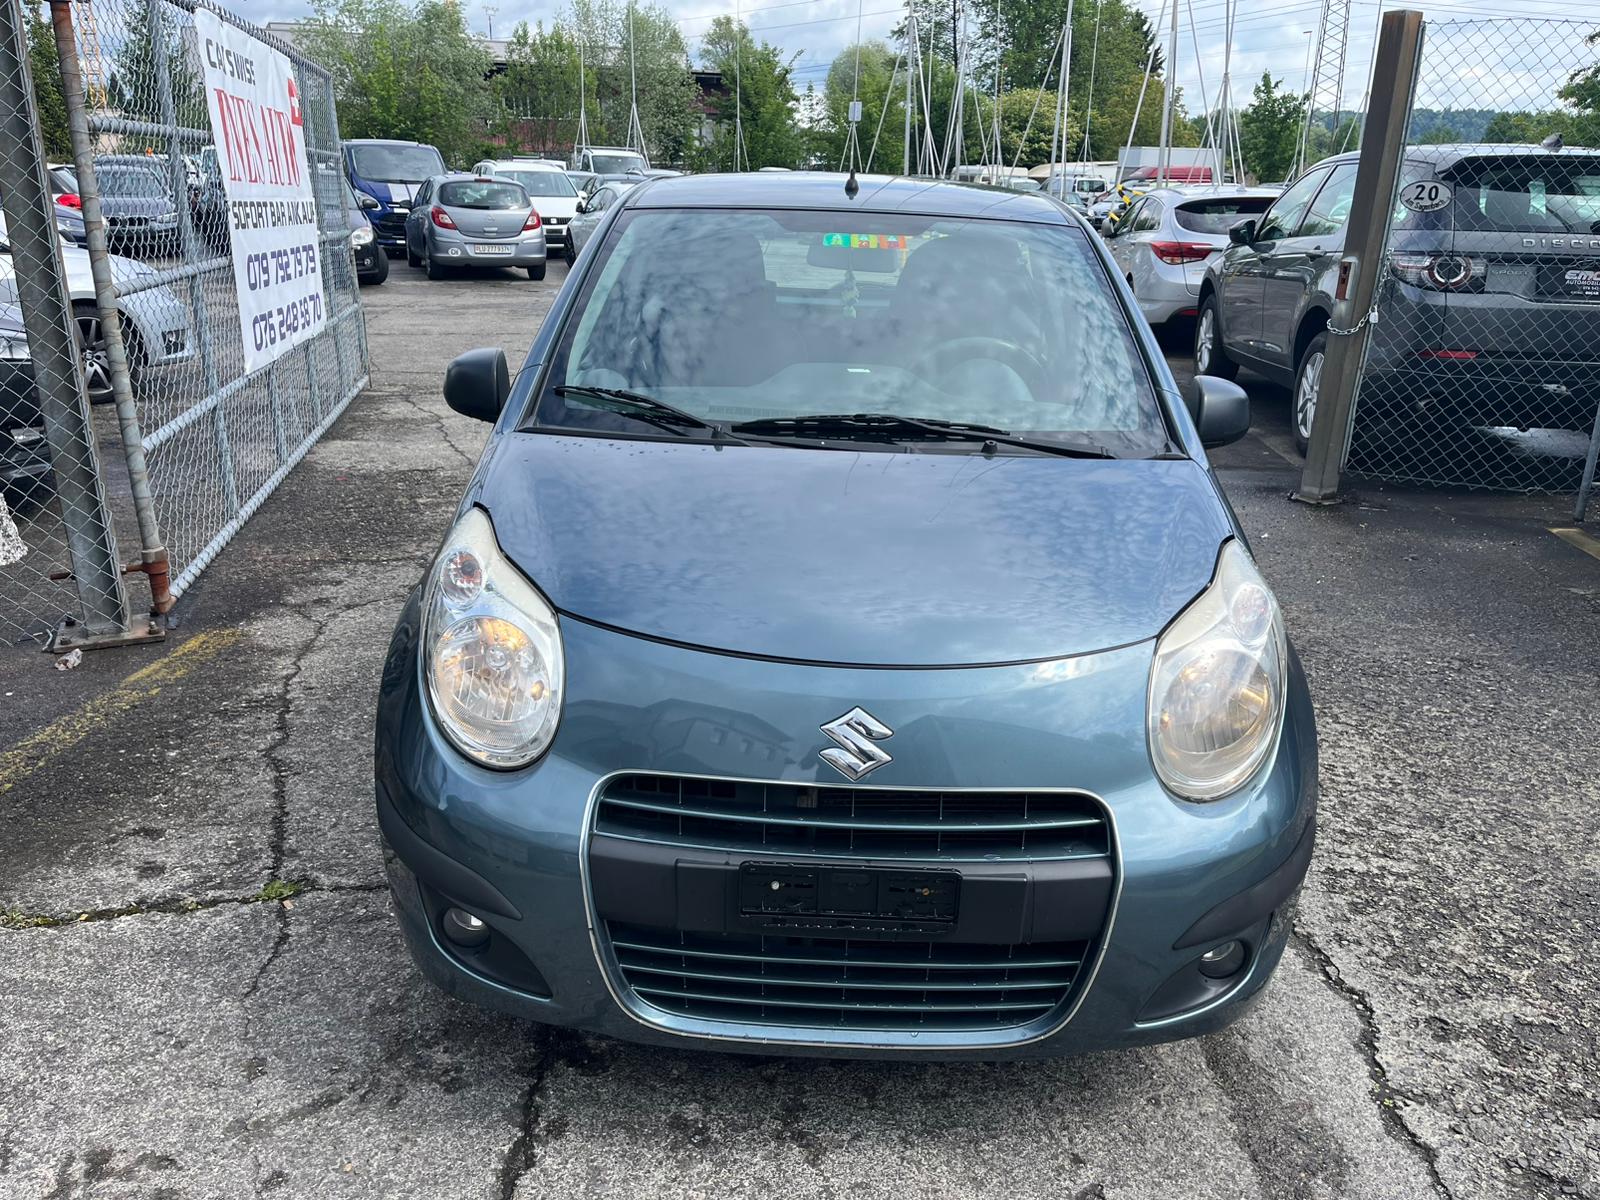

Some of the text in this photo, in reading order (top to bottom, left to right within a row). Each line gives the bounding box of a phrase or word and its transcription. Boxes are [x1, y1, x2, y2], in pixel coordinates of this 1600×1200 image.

[260, 104, 301, 188] AUTO
[231, 200, 269, 230] SOFORT
[268, 200, 288, 227] BAR
[1413, 183, 1440, 202] 20
[246, 243, 317, 291] 079 792 79 79
[252, 291, 322, 352] 076 248 58 70
